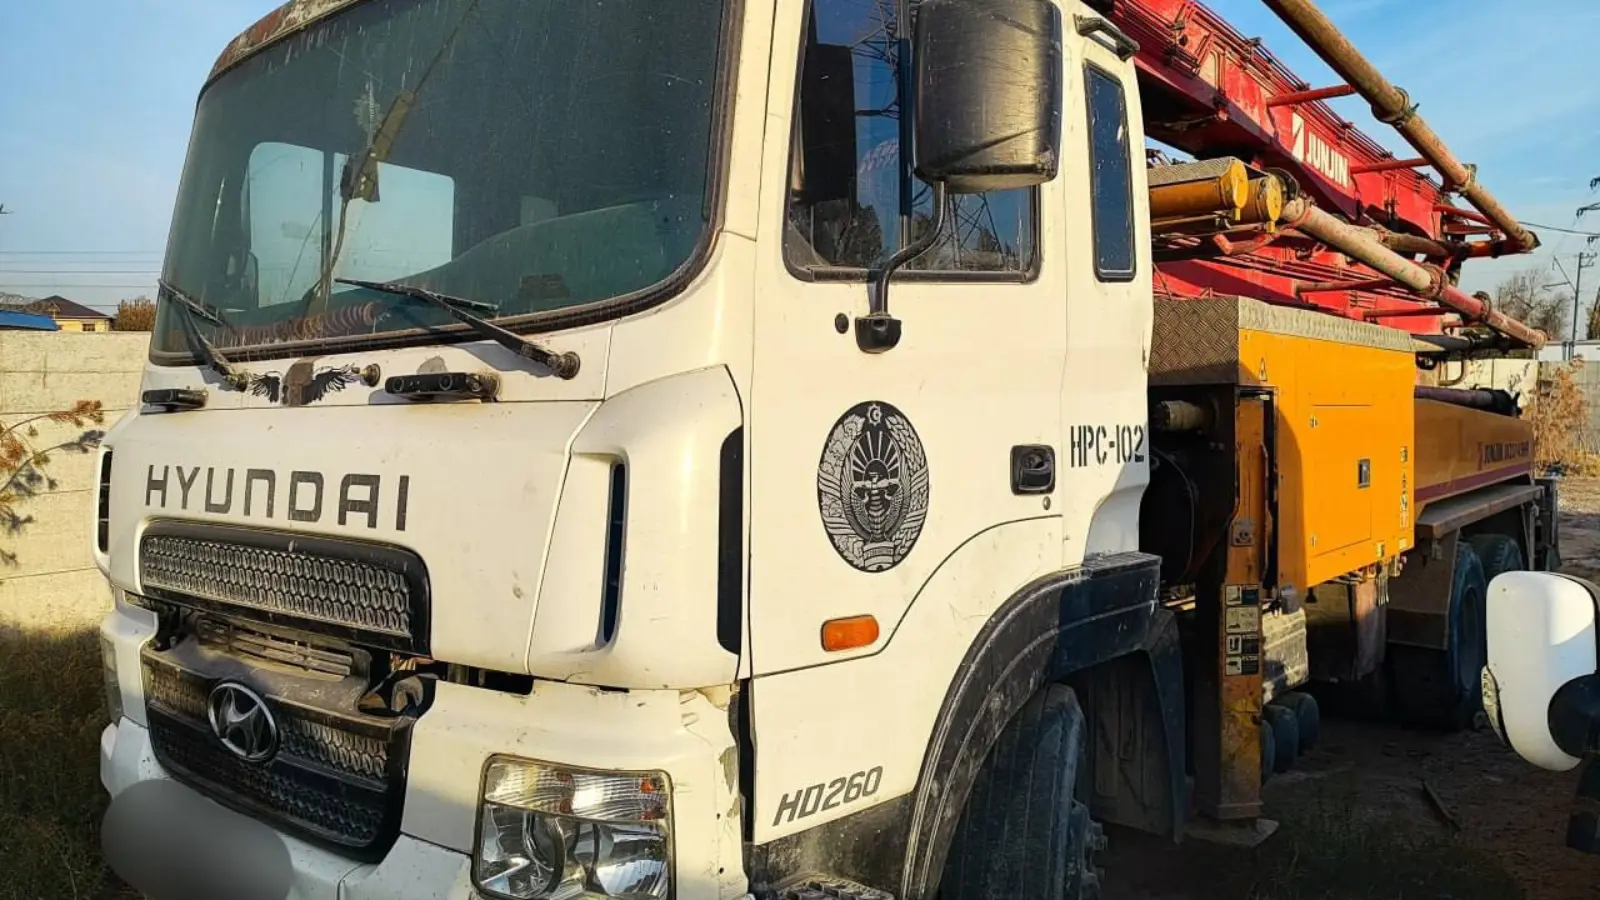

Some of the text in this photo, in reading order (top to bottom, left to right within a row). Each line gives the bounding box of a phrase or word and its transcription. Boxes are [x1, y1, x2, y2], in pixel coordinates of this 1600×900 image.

[1306, 130, 1348, 189] JUNJIN
[1070, 424, 1144, 468] HPC-102
[145, 465, 409, 531] HYUNDAI
[772, 765, 884, 827] HD260
